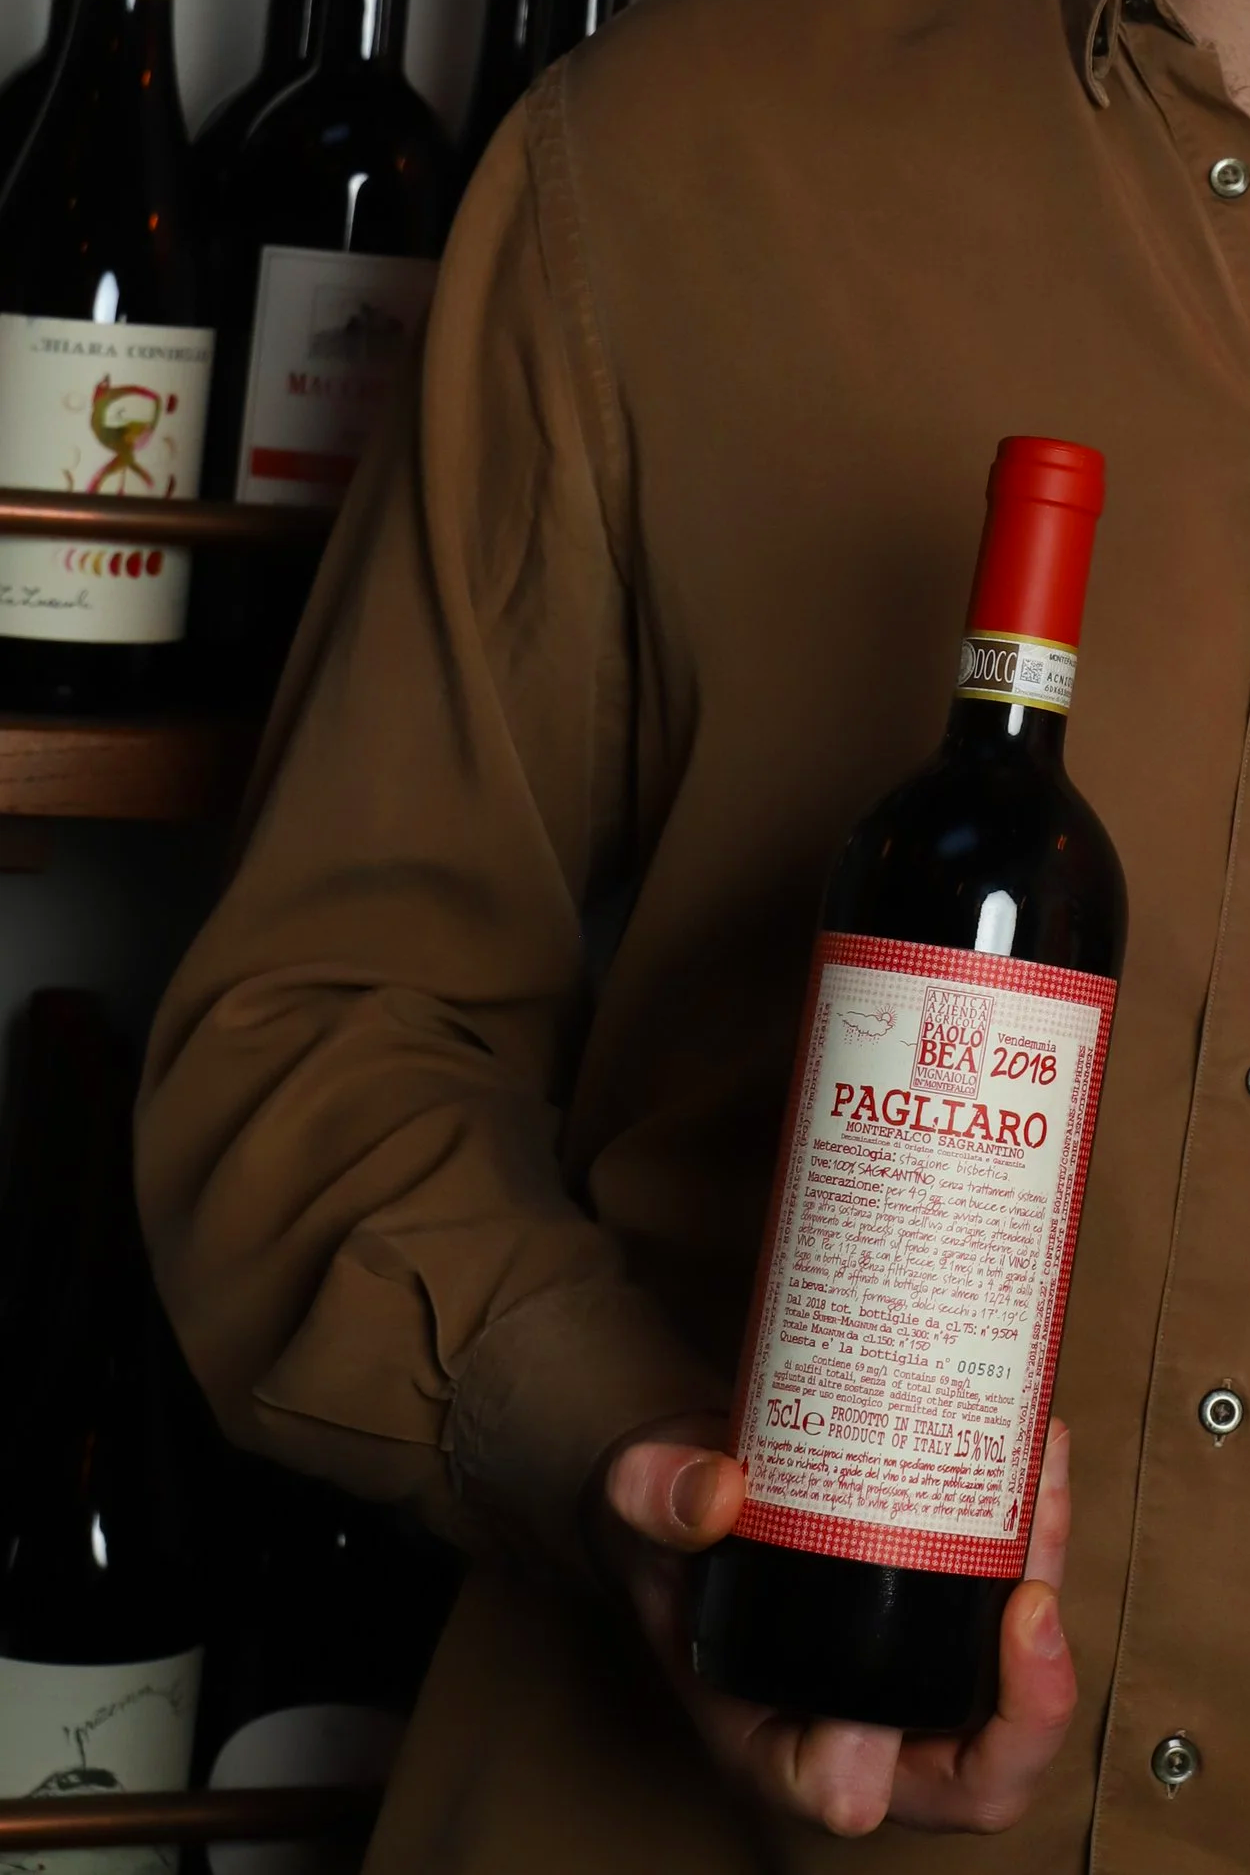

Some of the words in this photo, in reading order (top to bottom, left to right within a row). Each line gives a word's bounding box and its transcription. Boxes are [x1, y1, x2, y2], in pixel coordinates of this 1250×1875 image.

[975, 648, 1017, 684] DOCG
[926, 1001, 987, 1021] AZIENDA
[927, 989, 987, 1011] ANTICA
[921, 1021, 984, 1048] PAOLO
[924, 1012, 986, 1031] AGRICOLA
[918, 1039, 977, 1074] BEA
[998, 1033, 1056, 1053] Vendemmia
[916, 1066, 978, 1087] VIGNAIOLO
[990, 1047, 1057, 1085] 2018
[925, 1080, 976, 1096] MONTEFALCO
[832, 1083, 1047, 1148] PAGLIARO
[841, 1133, 891, 1147] Denominazione
[904, 1143, 934, 1154] Origine
[846, 1121, 931, 1144] MONTEFALCO
[938, 1135, 1025, 1159] SAGRANTINO
[813, 1139, 896, 1162] Metereologia:
[899, 1153, 949, 1174] stagione
[810, 1155, 832, 1170] Uve:
[832, 1159, 857, 1176] 100%
[858, 1162, 935, 1188] SAGRANTINO,
[938, 1178, 964, 1191] senza
[968, 1182, 1015, 1198] trattamenti
[807, 1171, 884, 1193] Macerazione:
[884, 1186, 906, 1200] per
[908, 1185, 927, 1205] 49
[947, 1197, 967, 1207] con
[968, 1196, 998, 1212] bucce
[804, 1186, 880, 1209] Lavorazione:
[883, 1197, 948, 1218] fermentazione
[985, 1218, 1000, 1227] con
[788, 1276, 800, 1288] La
[800, 1277, 828, 1294] beva:
[911, 1296, 935, 1310] dolci
[784, 1306, 811, 1319] Totale
[879, 1323, 893, 1334] da
[786, 1293, 802, 1306] Dal
[805, 1296, 827, 1311] 2018
[830, 1302, 852, 1315] tot.
[859, 1306, 919, 1326] bottiglie
[925, 1317, 940, 1329] da
[782, 1319, 808, 1332] Totale
[810, 1322, 845, 1339] MAGNUM
[846, 1330, 859, 1341] da
[779, 1330, 816, 1348] Questa
[838, 1341, 853, 1355] la
[860, 1345, 928, 1367] bottiglia
[957, 1360, 1011, 1379] 005831
[811, 1355, 852, 1370] Contiene
[854, 1361, 865, 1372] 69
[772, 1370, 806, 1387] aggiunta
[807, 1375, 817, 1386] di
[818, 1378, 843, 1390] altre
[844, 1383, 885, 1397] sostanze
[794, 1363, 823, 1376] solfiti
[826, 1369, 856, 1384] totali,
[860, 1375, 886, 1387] senza
[893, 1369, 936, 1383] Contains
[939, 1375, 950, 1385] 69
[801, 1387, 817, 1397] per
[819, 1390, 835, 1400] uso
[835, 1393, 883, 1408] enologico
[889, 1390, 923, 1405] adding
[926, 1397, 953, 1408] other
[957, 1401, 998, 1414] substance
[906, 1382, 931, 1394] total
[935, 1387, 981, 1403] sulphites,
[985, 1393, 1015, 1405] without
[831, 1405, 889, 1428] PRODOTTO
[893, 1416, 910, 1431] IN
[913, 1419, 953, 1439] ITALIA
[887, 1402, 938, 1416] permitted
[941, 1408, 957, 1419] for
[961, 1411, 981, 1423] wine
[984, 1415, 1012, 1429] making
[828, 1423, 886, 1446] PRODUCT
[891, 1432, 908, 1450] OF
[913, 1436, 952, 1456] ITALY
